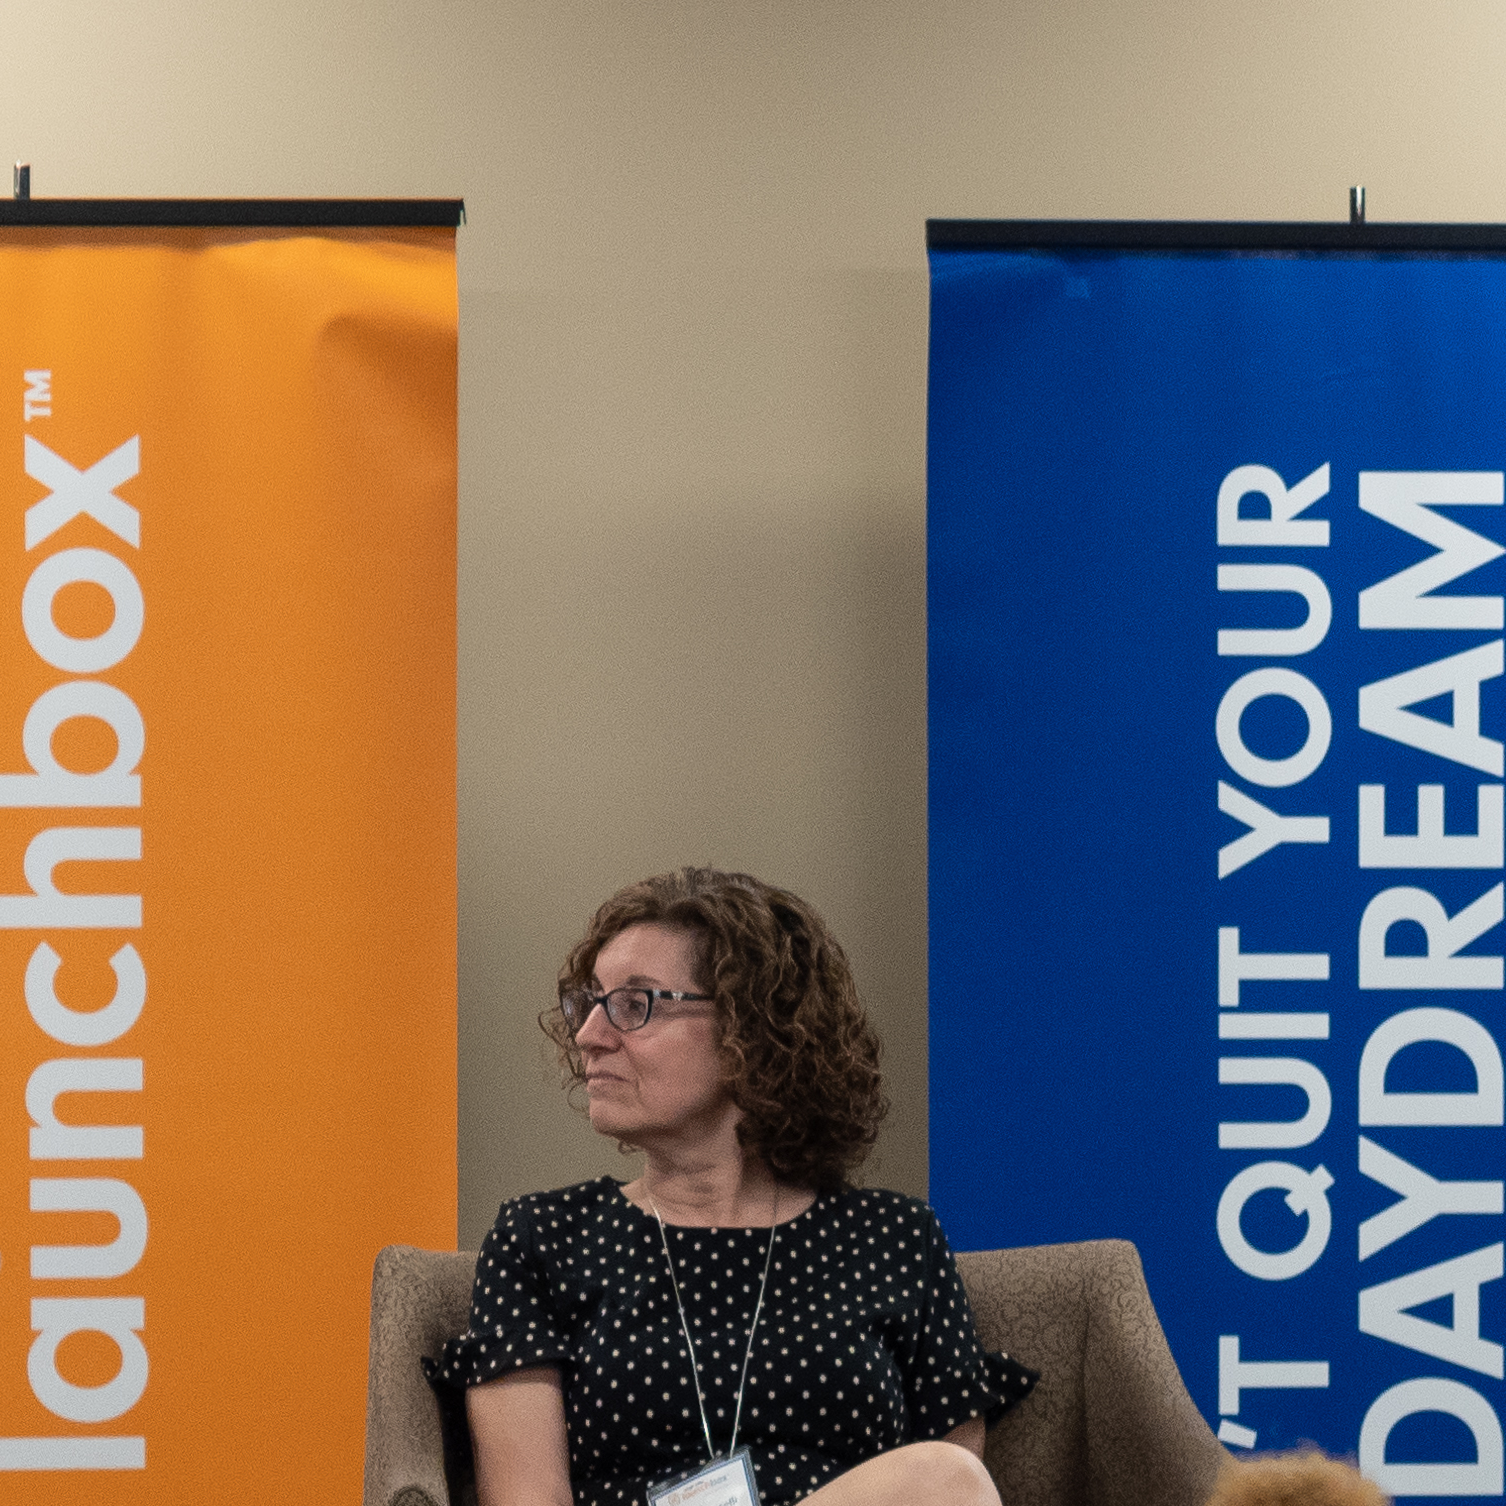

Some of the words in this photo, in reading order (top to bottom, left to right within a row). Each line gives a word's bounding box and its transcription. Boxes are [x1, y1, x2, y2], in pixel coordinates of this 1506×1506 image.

[1215, 462, 1333, 880] YOUR
[1216, 927, 1335, 1281] QUIT
[1358, 471, 1506, 1497] DAYDREAM
